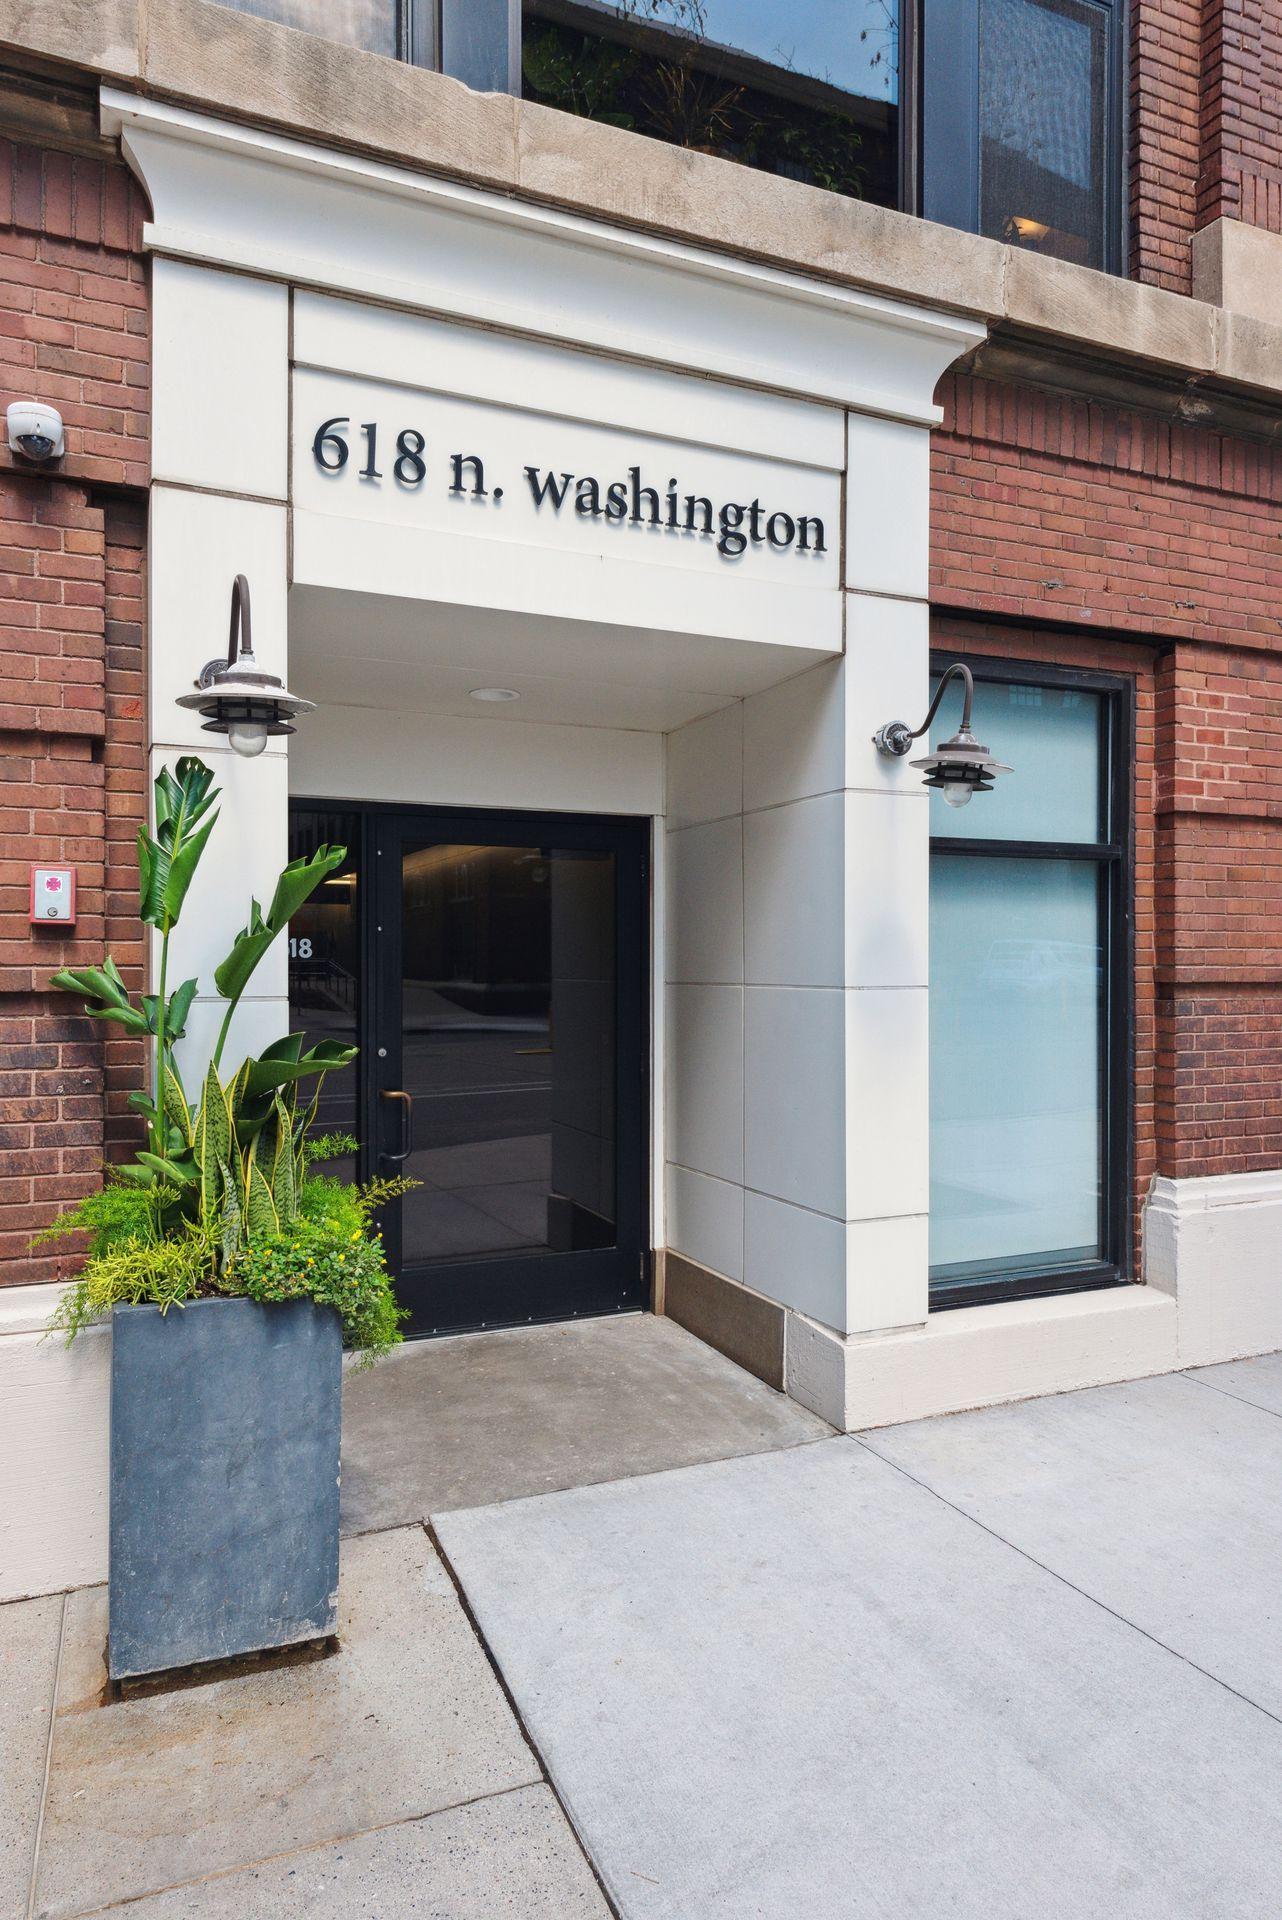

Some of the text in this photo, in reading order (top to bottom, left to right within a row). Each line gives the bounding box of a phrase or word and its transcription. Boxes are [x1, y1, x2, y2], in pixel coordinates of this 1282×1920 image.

[312, 417, 828, 556] 618 n. washington
[288, 938, 313, 959] 18
